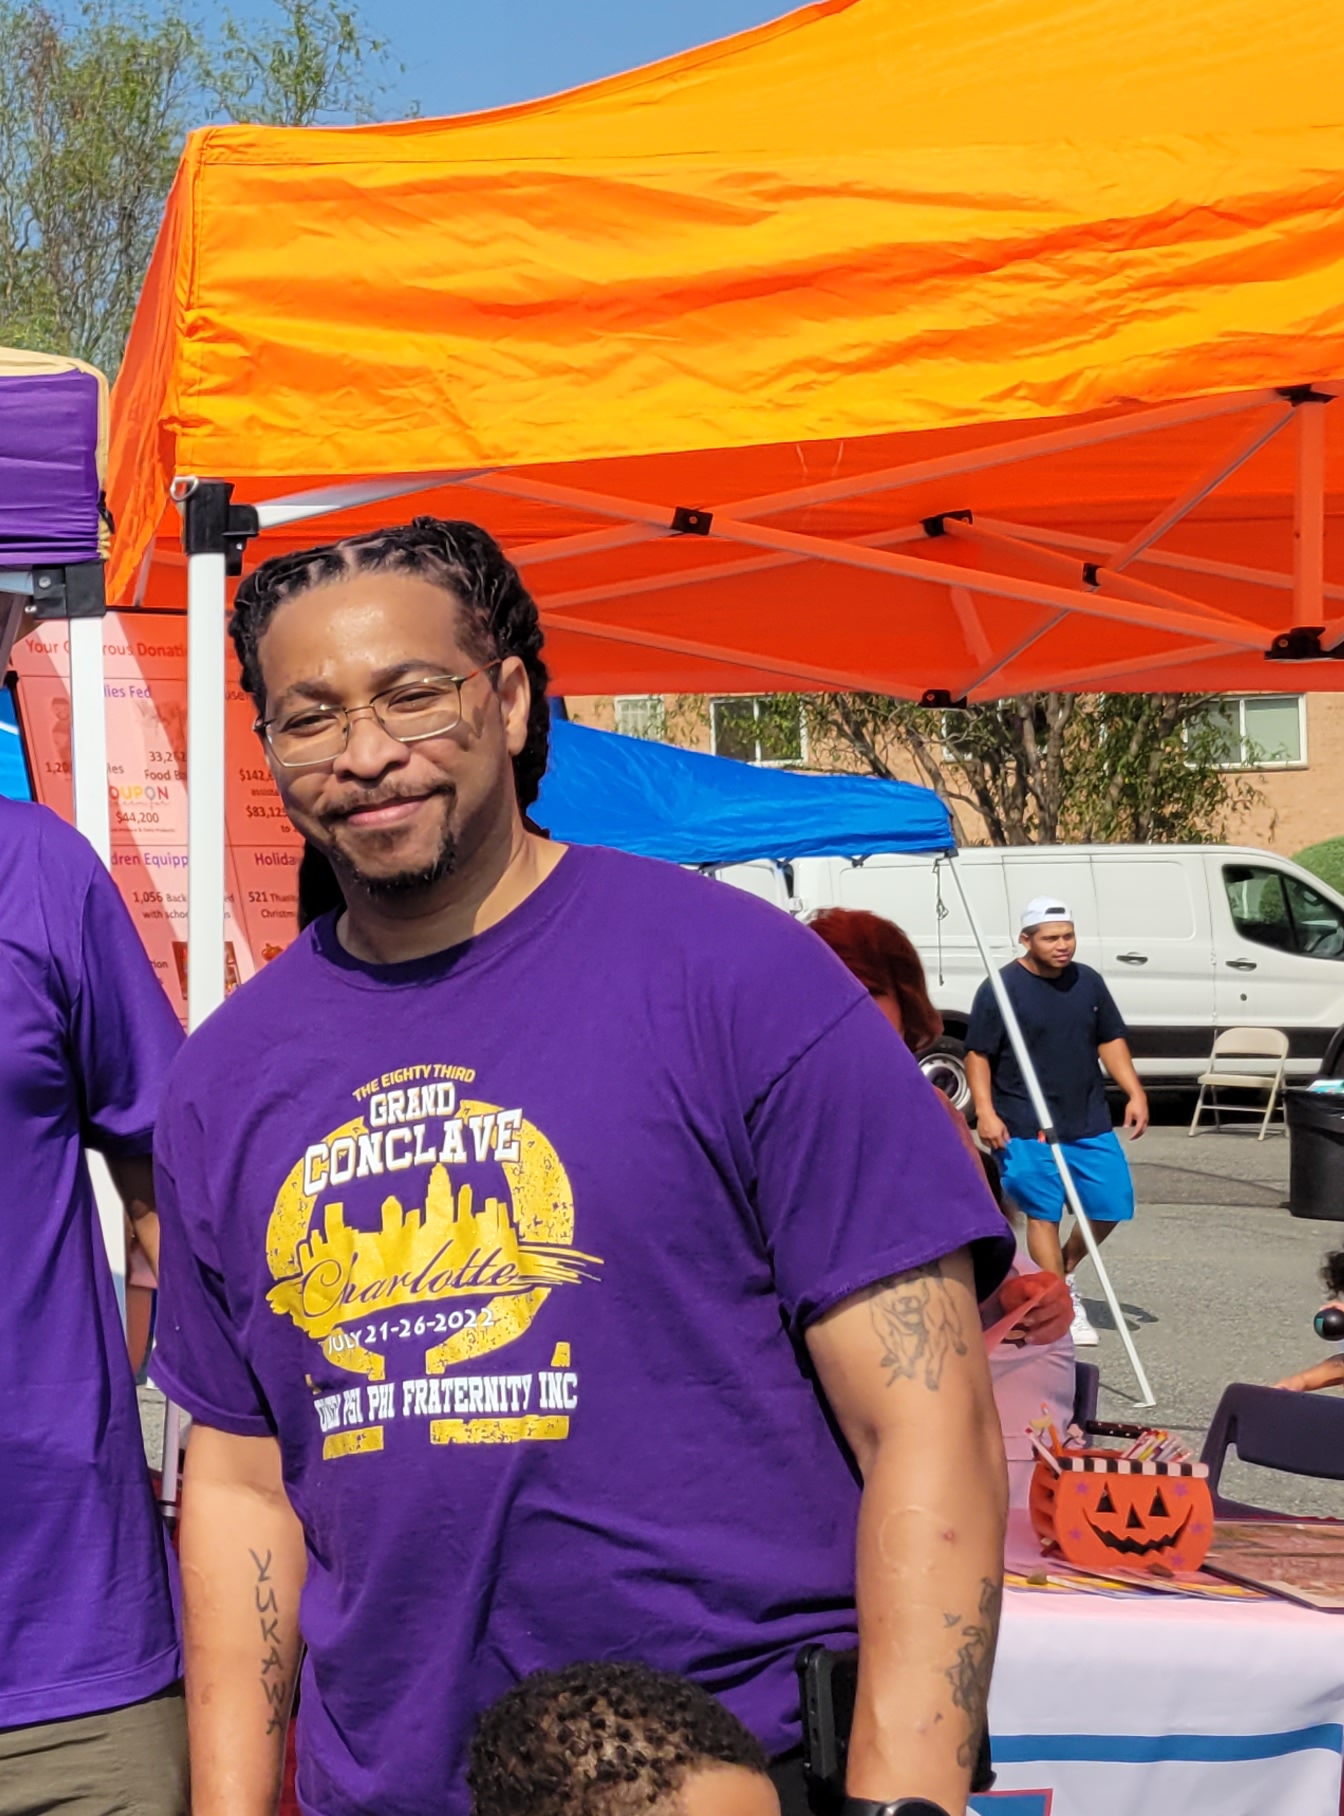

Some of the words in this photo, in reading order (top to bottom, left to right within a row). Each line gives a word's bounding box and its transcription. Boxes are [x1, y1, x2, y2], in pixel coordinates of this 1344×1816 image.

[25, 639, 58, 654] Your
[129, 685, 151, 699] Fed
[144, 769, 171, 781] Food
[108, 785, 170, 801] OUPON
[116, 811, 160, 824] $44,200
[144, 853, 188, 868] Equipp
[254, 852, 296, 866] Holida
[248, 891, 268, 903] 521
[352, 1078, 380, 1102] THE
[381, 1064, 432, 1088] EIGHTY
[433, 1064, 476, 1083] THIRD
[369, 1081, 456, 1128] GRAND
[302, 1108, 524, 1197] CONCLAVE
[300, 1239, 524, 1319] Charlotte
[328, 1330, 363, 1356] JULY
[364, 1307, 496, 1344] 21-26-2022
[367, 1382, 396, 1422] PHI
[402, 1373, 533, 1417] FRATERNITY
[538, 1370, 579, 1410] INC
